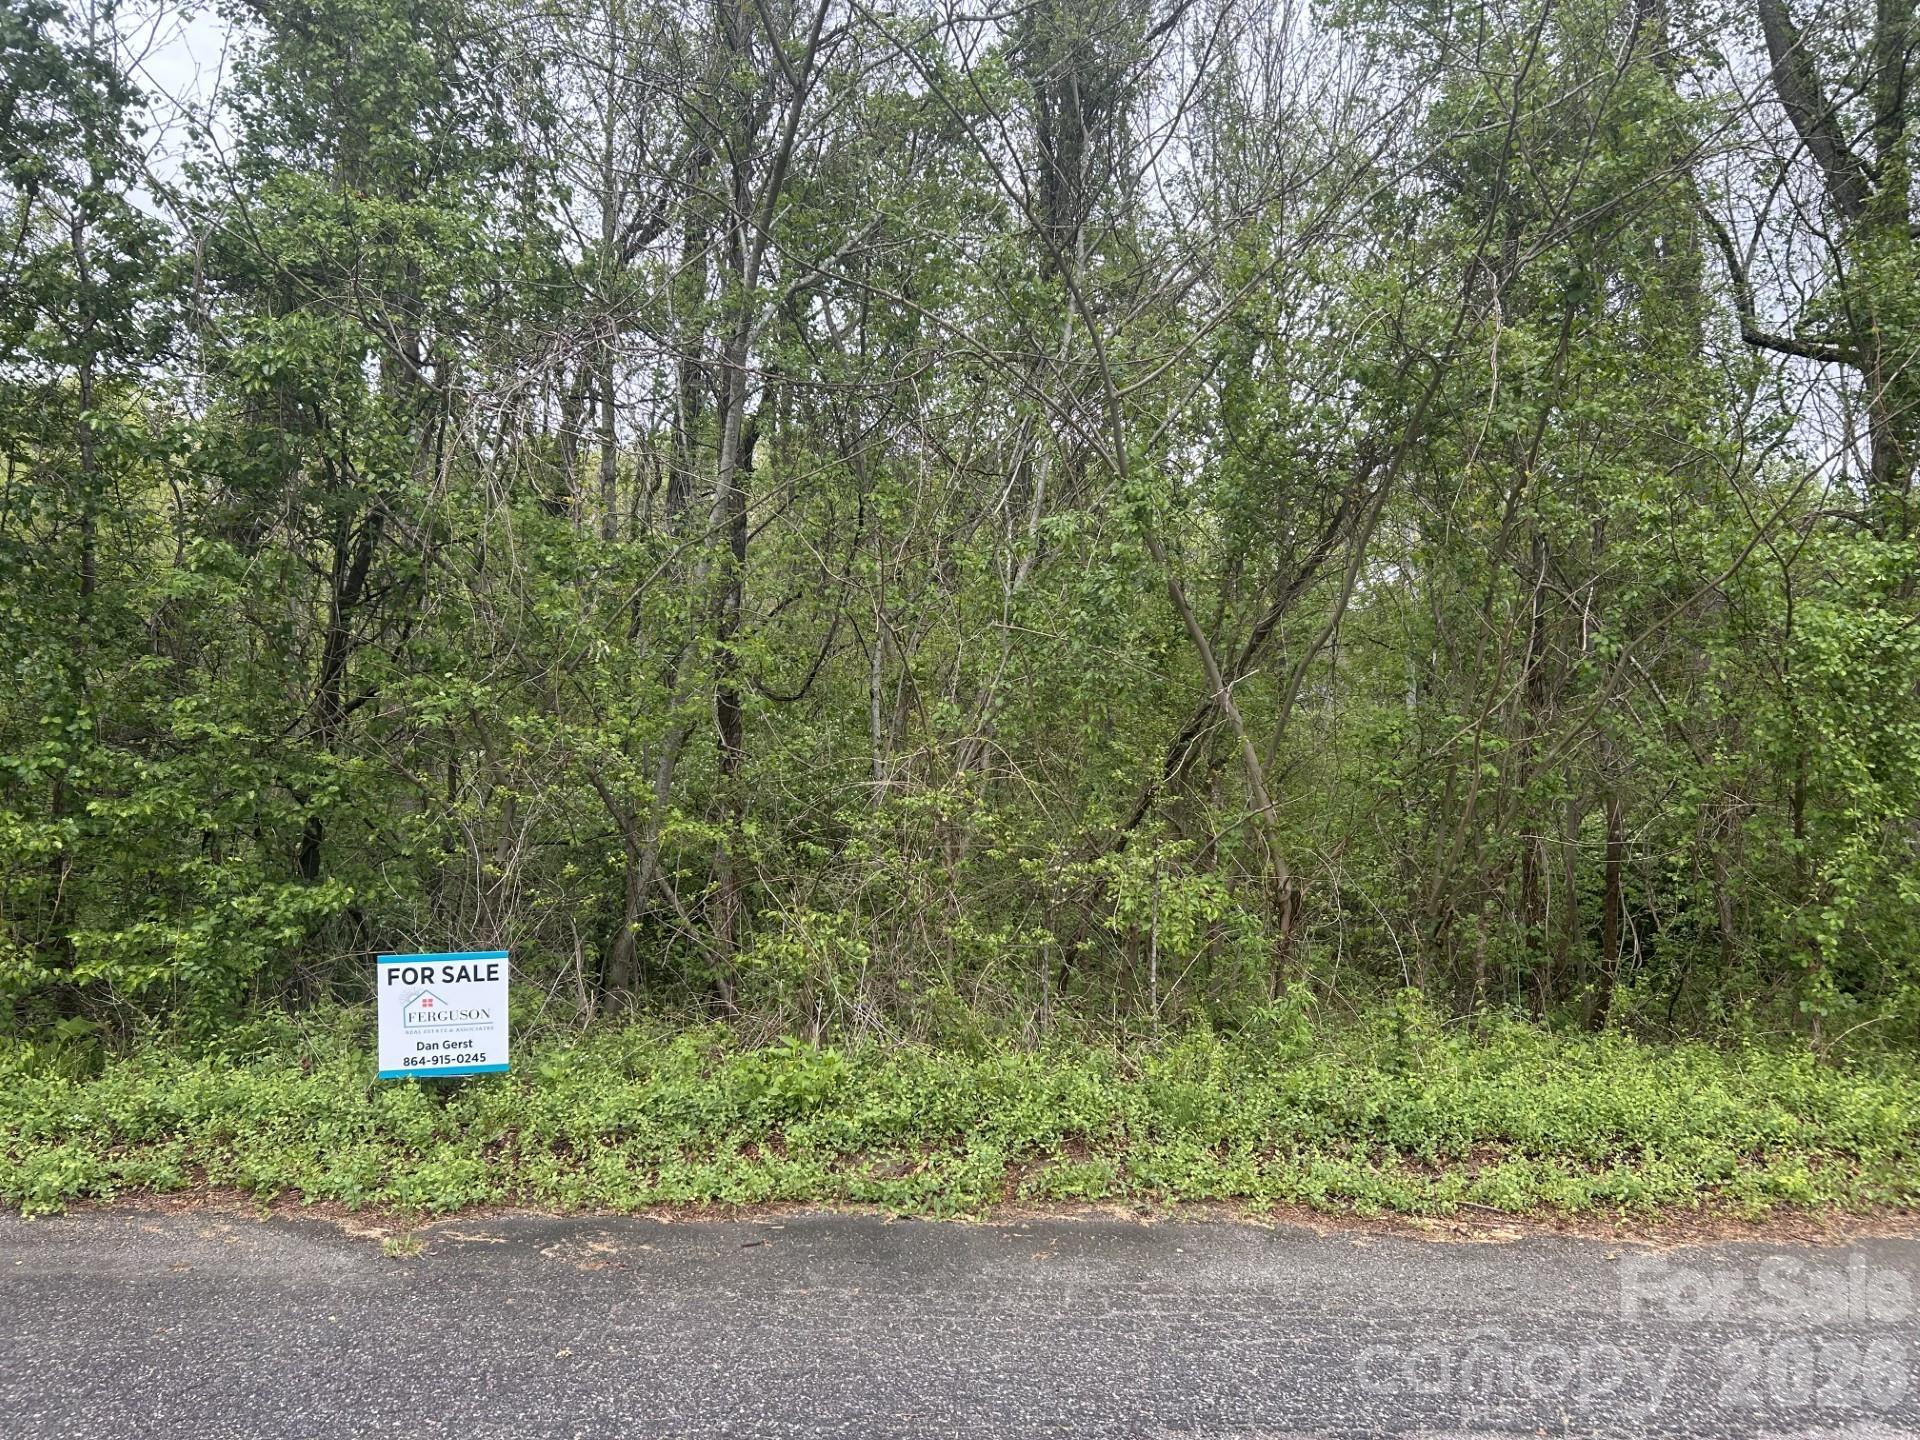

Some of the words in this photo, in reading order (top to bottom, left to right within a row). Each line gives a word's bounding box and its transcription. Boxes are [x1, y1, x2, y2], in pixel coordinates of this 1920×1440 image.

[387, 966, 435, 986] FOR
[442, 963, 500, 984] SALE
[408, 1008, 491, 1023] FERGUSON
[416, 1041, 439, 1051] Dan
[442, 1039, 473, 1050] Gerst
[403, 1053, 487, 1066] 864-915-0245
